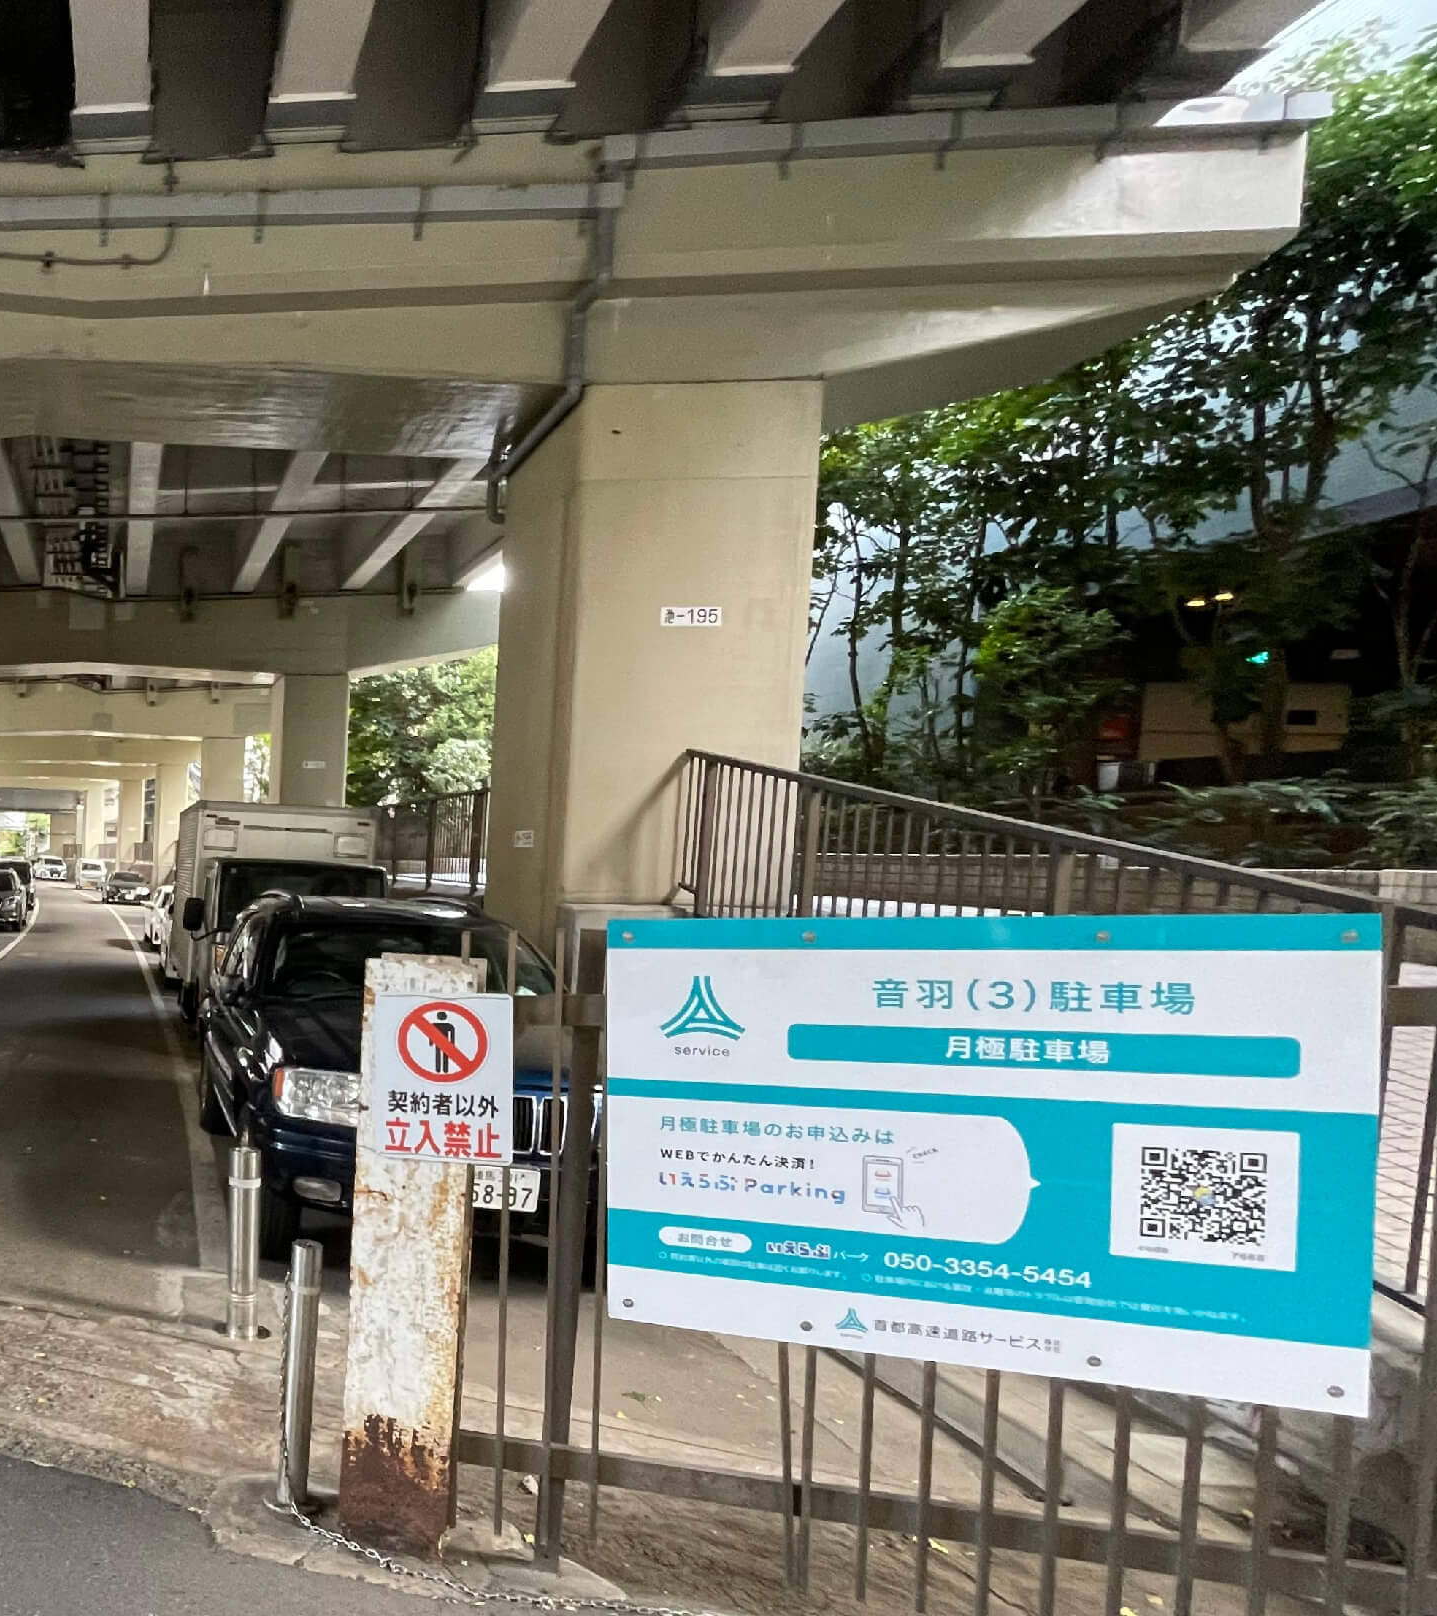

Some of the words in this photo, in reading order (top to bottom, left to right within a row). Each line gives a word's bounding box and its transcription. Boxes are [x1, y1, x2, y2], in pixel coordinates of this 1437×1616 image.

[674, 1045, 731, 1058] service
[945, 1035, 1111, 1065] 月極駐車場
[387, 1089, 500, 1118] 契約者以外
[384, 1116, 502, 1159] 立入禁止
[660, 1115, 895, 1145] 月極駐車場のお申込みは
[659, 1171, 738, 1192] いえらぶ
[744, 1177, 846, 1205] Parking
[677, 1231, 733, 1248] お問合せ
[883, 1251, 1092, 1289] 050-3354-5454
